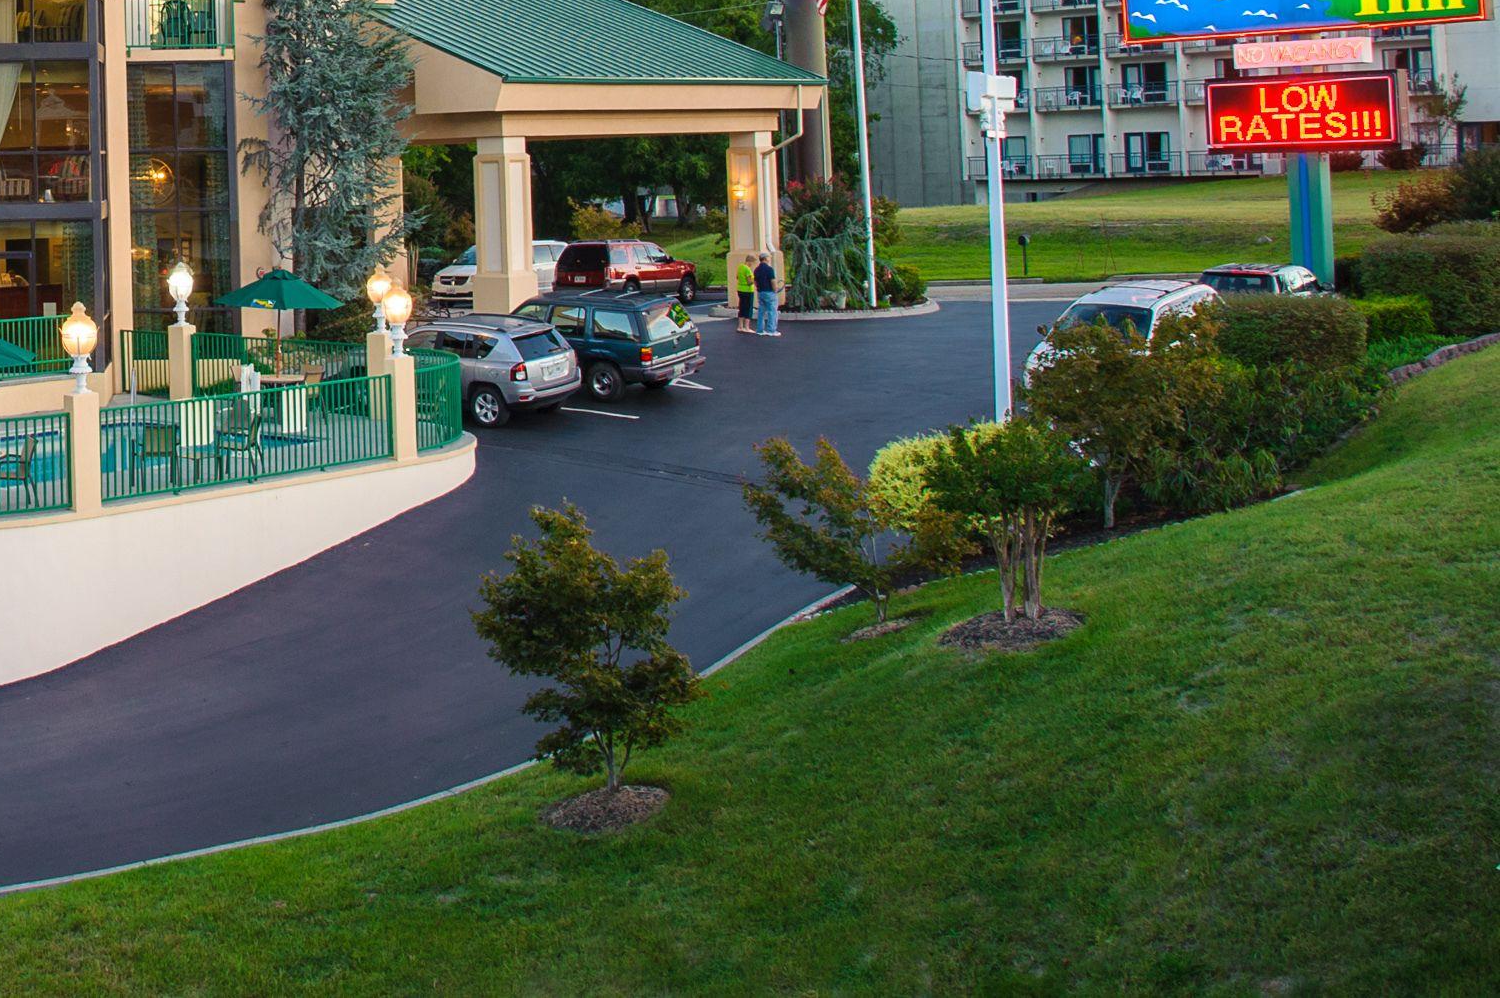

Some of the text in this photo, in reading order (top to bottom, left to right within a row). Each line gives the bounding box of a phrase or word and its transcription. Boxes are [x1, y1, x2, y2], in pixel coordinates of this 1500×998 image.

[1237, 40, 1364, 63] NO VACANCY
[1259, 84, 1338, 113] LOW
[1219, 109, 1383, 142] RATES!!!
